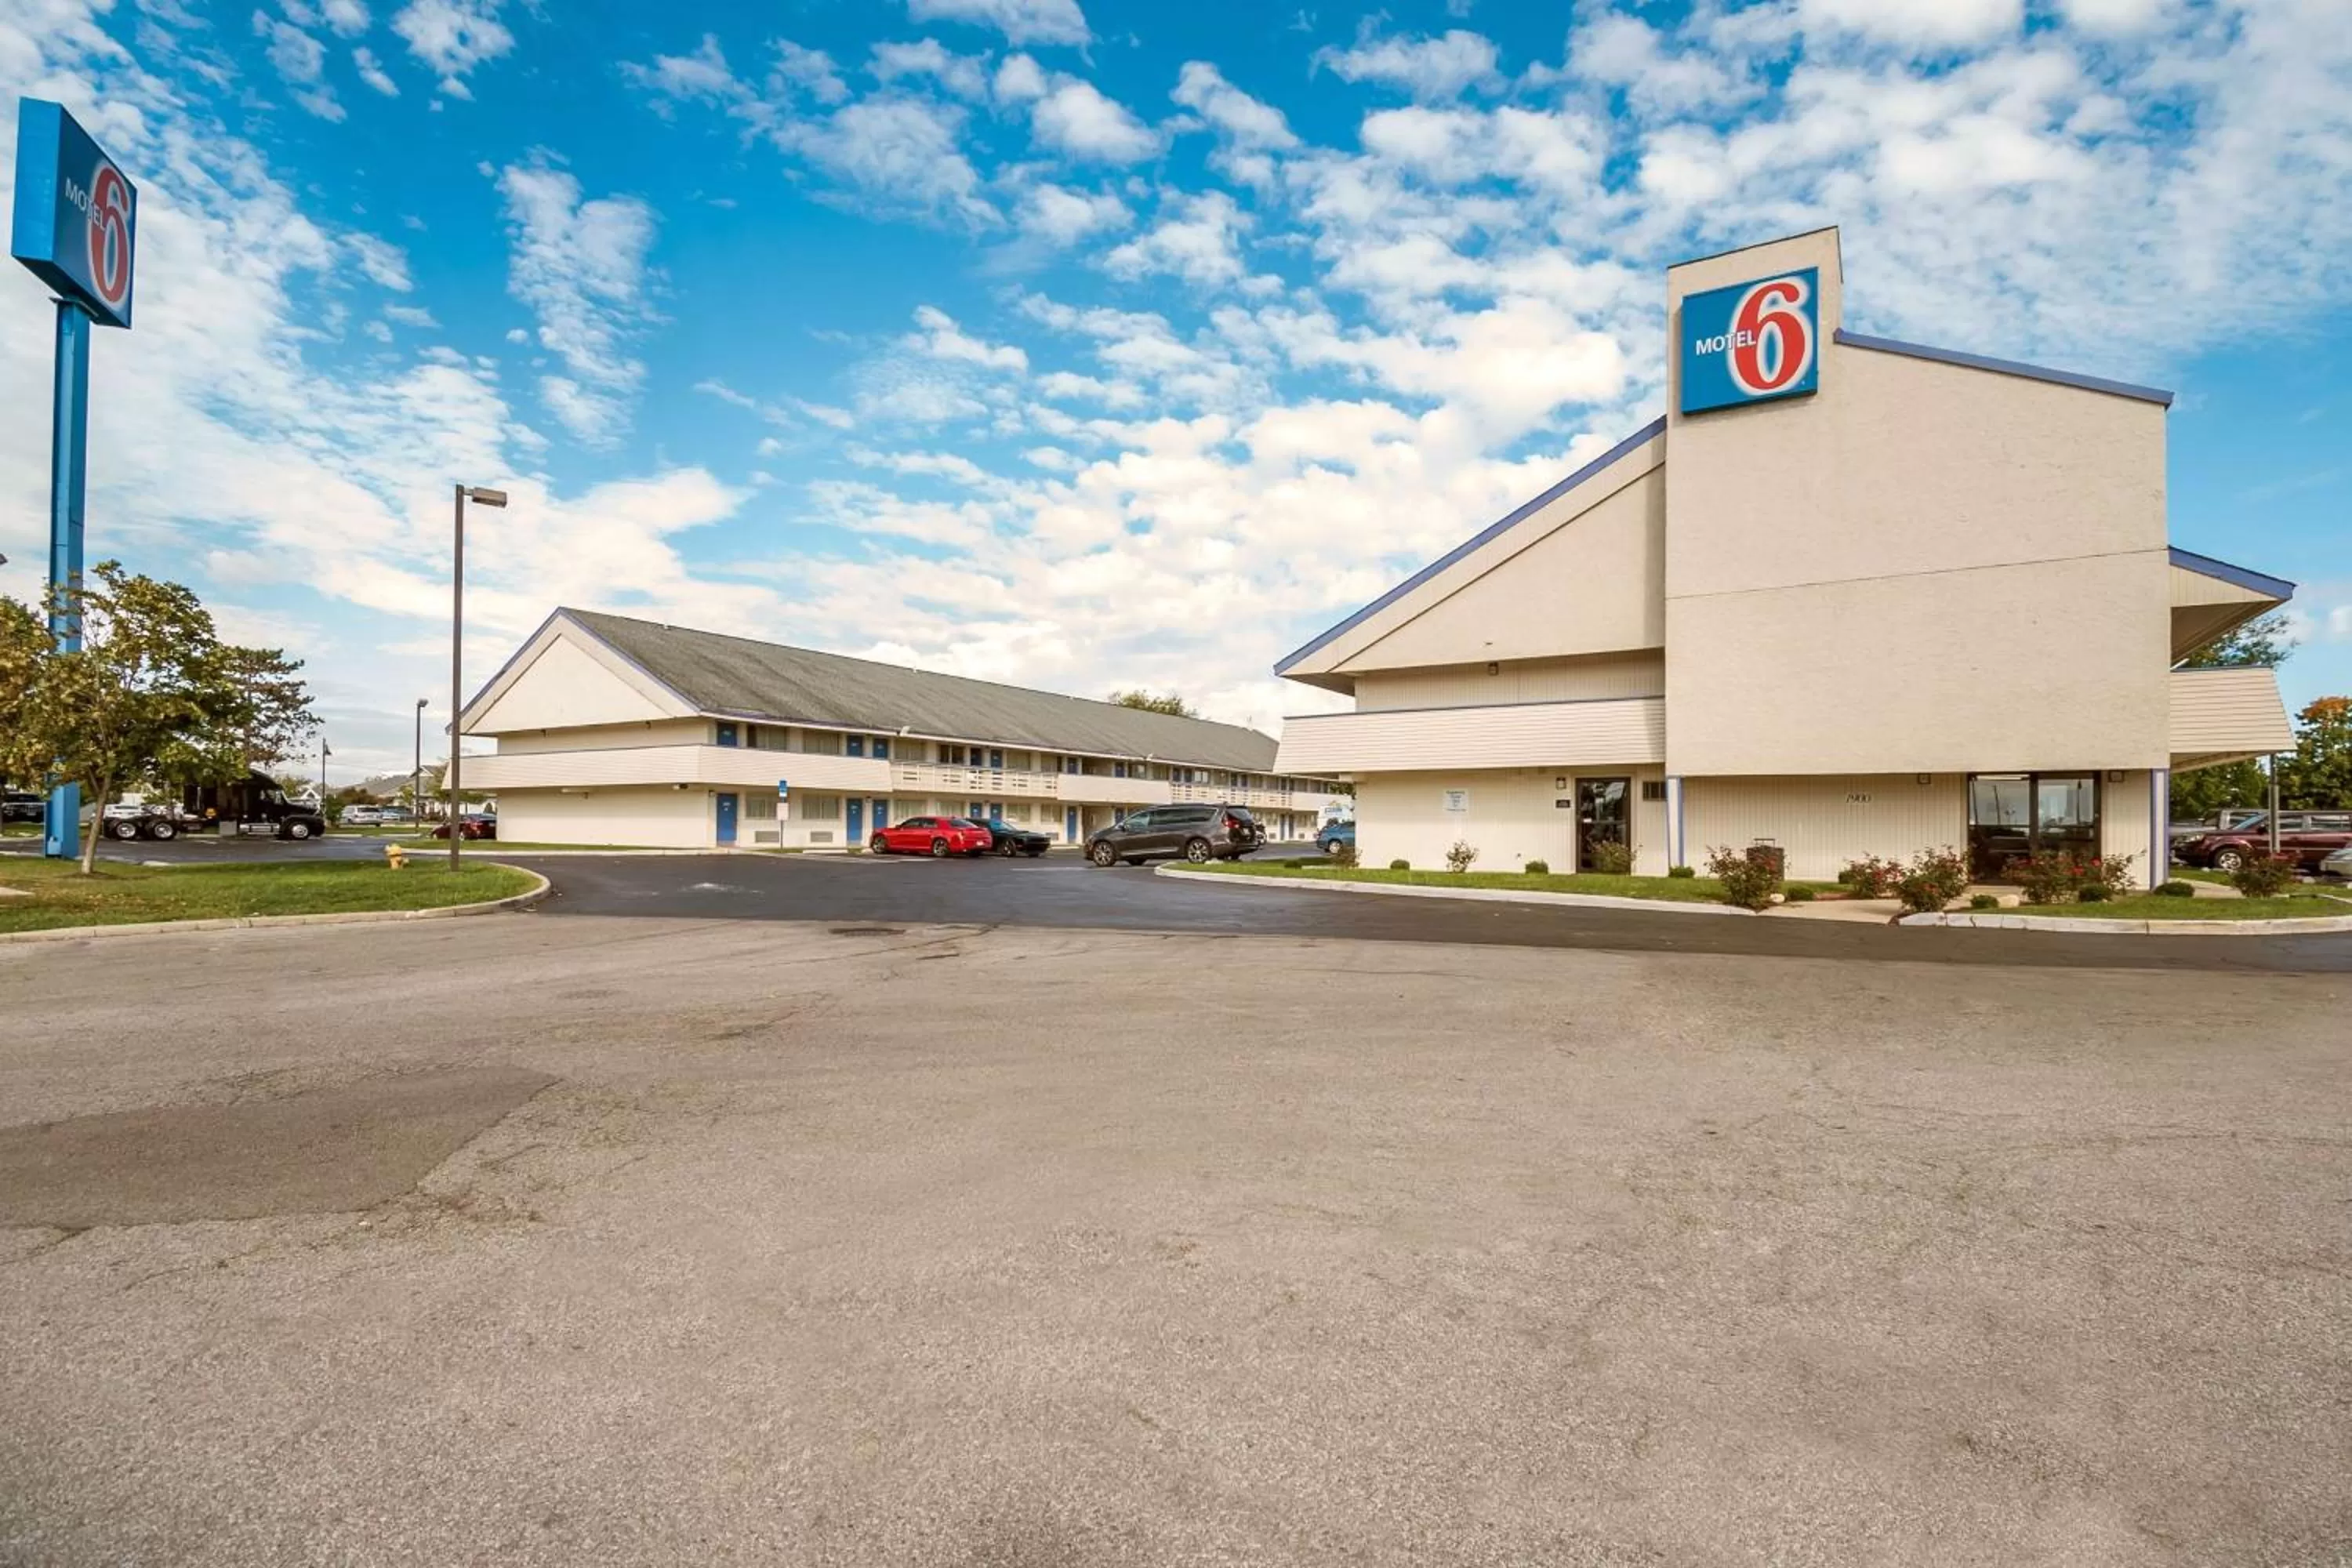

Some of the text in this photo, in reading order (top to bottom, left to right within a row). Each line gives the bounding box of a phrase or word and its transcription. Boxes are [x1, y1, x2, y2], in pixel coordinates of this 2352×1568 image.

[65, 165, 130, 306] MOTEL 6
[1696, 280, 1808, 392] MOTEL 6
